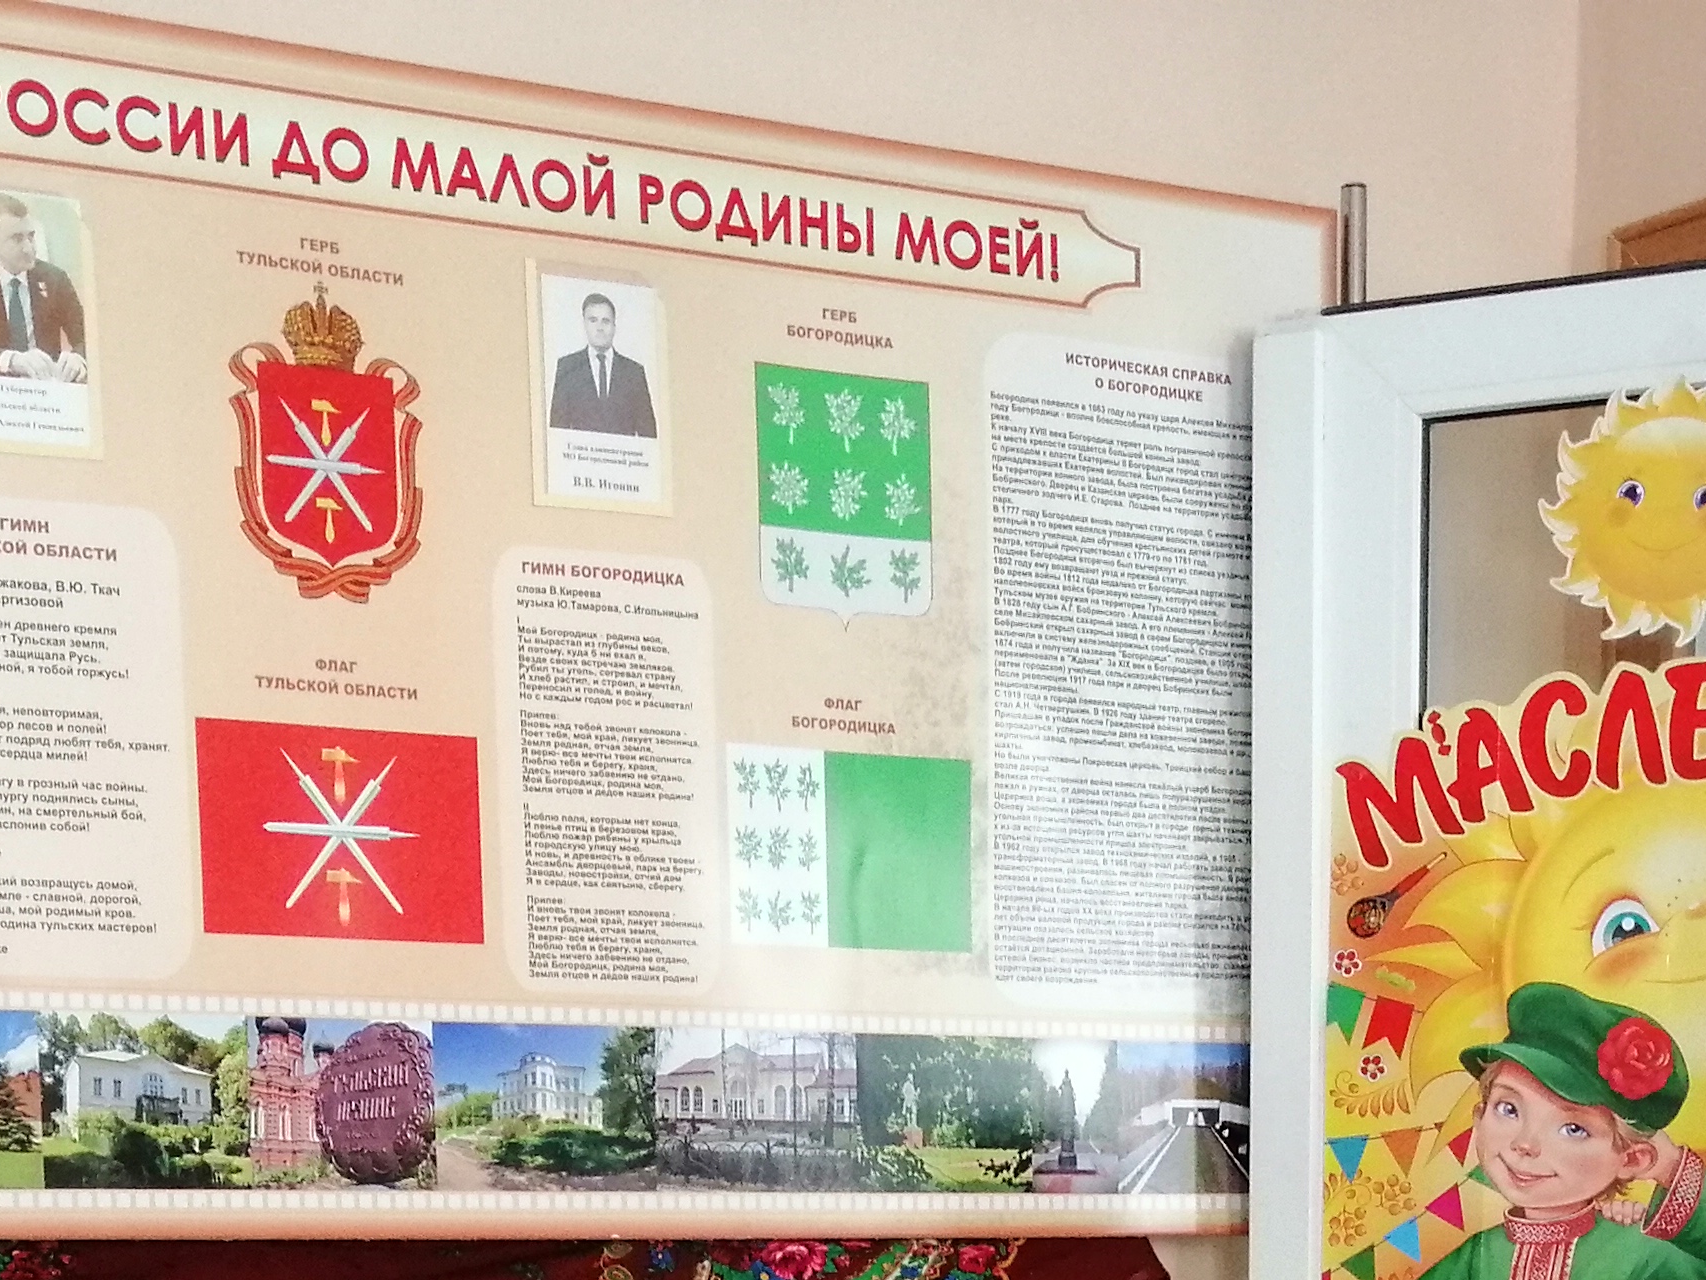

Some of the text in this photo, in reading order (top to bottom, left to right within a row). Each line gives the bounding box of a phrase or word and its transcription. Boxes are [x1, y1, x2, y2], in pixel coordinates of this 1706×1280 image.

[271, 121, 370, 185] ДО
[391, 138, 616, 220] МАЛОЙ
[638, 174, 875, 257] РОДИНЫ
[895, 212, 1061, 283] МОЕЙ!
[300, 237, 339, 254] ГЕРБ
[237, 250, 403, 287] ТУЛЬСКОЙ ОБЛАСТИ
[823, 308, 856, 323] ГЕРБ
[787, 324, 893, 349] БОГОРОДИЦКА
[1066, 352, 1232, 386] ИСТОРИЧЕСКАЯ СПРАВКА
[1095, 377, 1202, 403] О БОГОРОДИЦКЕ
[0, 517, 49, 533] ГИМН
[34, 543, 116, 562] ОБЛАСТИ
[522, 561, 684, 587] ГИМН БОГОРОДИЦКА
[91, 582, 120, 596] Ткач
[517, 585, 546, 596] слова
[517, 598, 555, 610] музыка
[14, 621, 70, 633] древнего
[74, 626, 117, 636] кремля
[11, 633, 65, 647] Тульская
[4, 649, 65, 661] защищала
[38, 664, 73, 675] тобой
[77, 668, 128, 681] горжусь!
[315, 659, 357, 673] ФЛАГ
[255, 675, 417, 700] ТУЛЬСКОЙ ОБЛАСТИ
[824, 698, 862, 712] ФЛАГ
[13, 707, 102, 721] неповторимая,
[18, 721, 53, 732] лесов
[68, 724, 106, 734] полей!
[792, 715, 895, 736] БОГОРОДИЦКА
